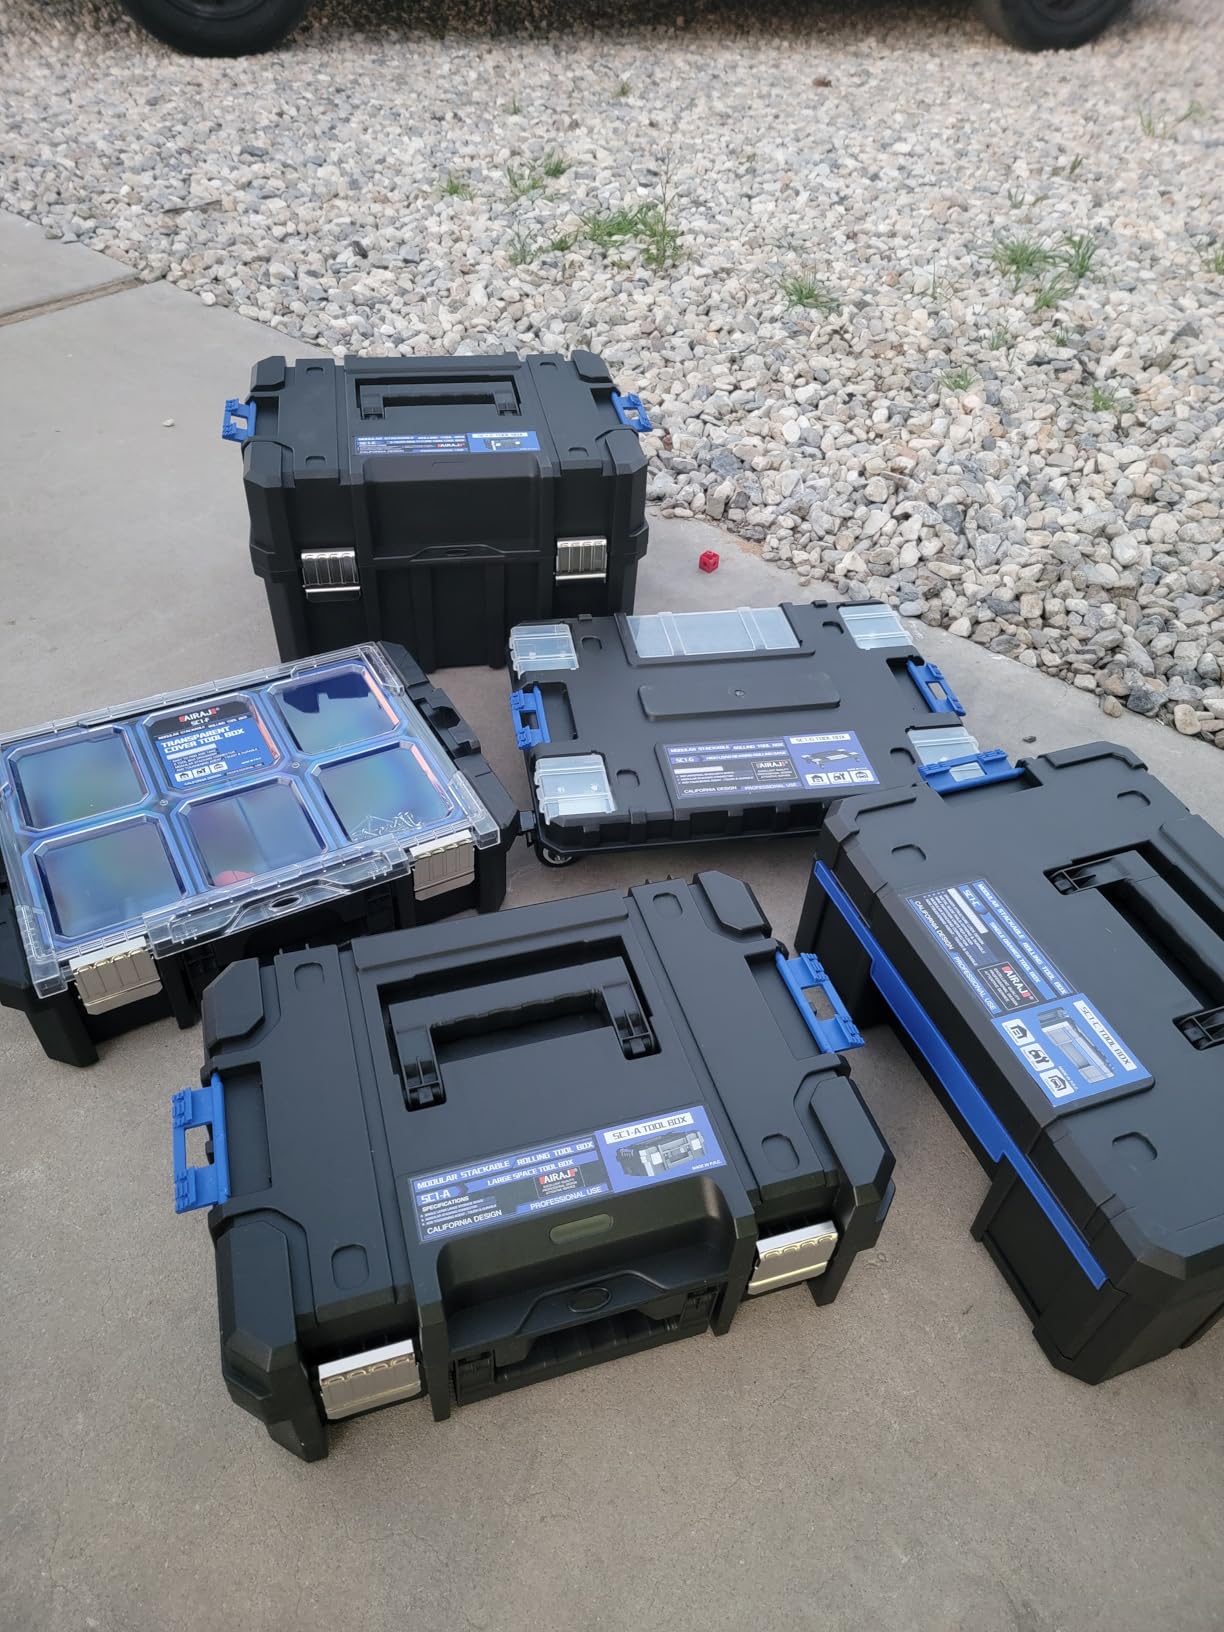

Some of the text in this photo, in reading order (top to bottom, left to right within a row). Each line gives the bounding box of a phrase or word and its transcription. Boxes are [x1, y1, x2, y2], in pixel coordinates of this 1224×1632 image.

[183, 709, 212, 721] AIRAJ
[161, 725, 230, 748] TRANSPARENT
[164, 728, 245, 754] COVER TOOL BOX
[915, 901, 954, 950] CALIFORNIA DESIGN
[953, 956, 997, 1011] PROFESSIONAL USE
[1004, 970, 1028, 994] AIRAJ
[1100, 1028, 1115, 1047] TOOL
[1115, 1047, 1131, 1065] BOX
[644, 1122, 667, 1132] TOOL
[667, 1116, 688, 1125] BOX
[416, 1141, 593, 1189] MODULAR STACKABLE ROLLING TOOL BOX
[487, 1159, 574, 1186] LARGE SPACE TOOL BOX
[543, 1170, 570, 1183] AIRAJ
[421, 1195, 469, 1212] SPECIFICATIONS
[529, 1186, 601, 1210] PROFESSIONAL USE
[426, 1217, 472, 1234] CALIFORNIA
[473, 1209, 502, 1222] DESIGN
